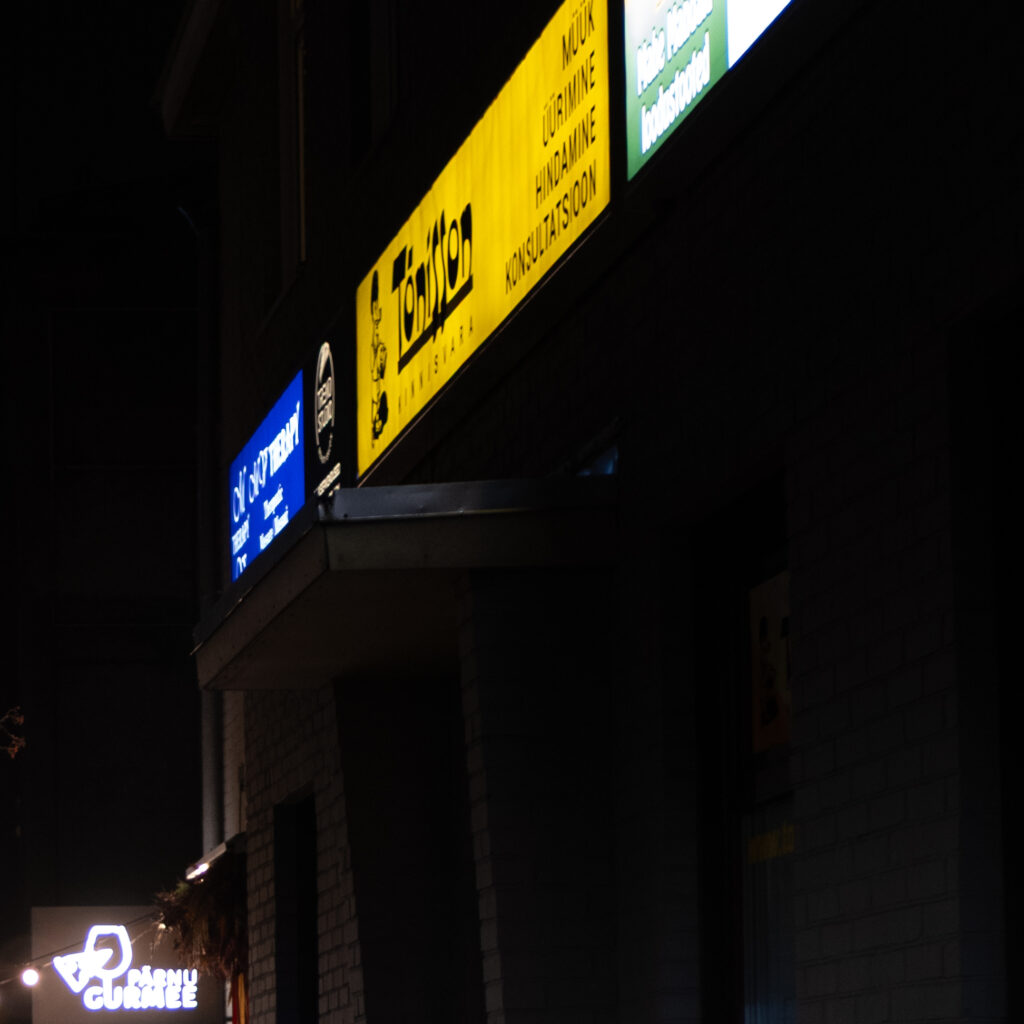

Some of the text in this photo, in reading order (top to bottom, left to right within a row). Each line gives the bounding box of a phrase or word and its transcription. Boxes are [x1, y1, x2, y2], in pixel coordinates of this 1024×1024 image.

[562, 0, 595, 71] MÜÜK
[543, 50, 595, 147] ÜÜRIMINE
[535, 105, 596, 209] HINDAMINE
[505, 159, 596, 295] KONSULTATSIOON
[82, 986, 198, 1010] GURMEE
